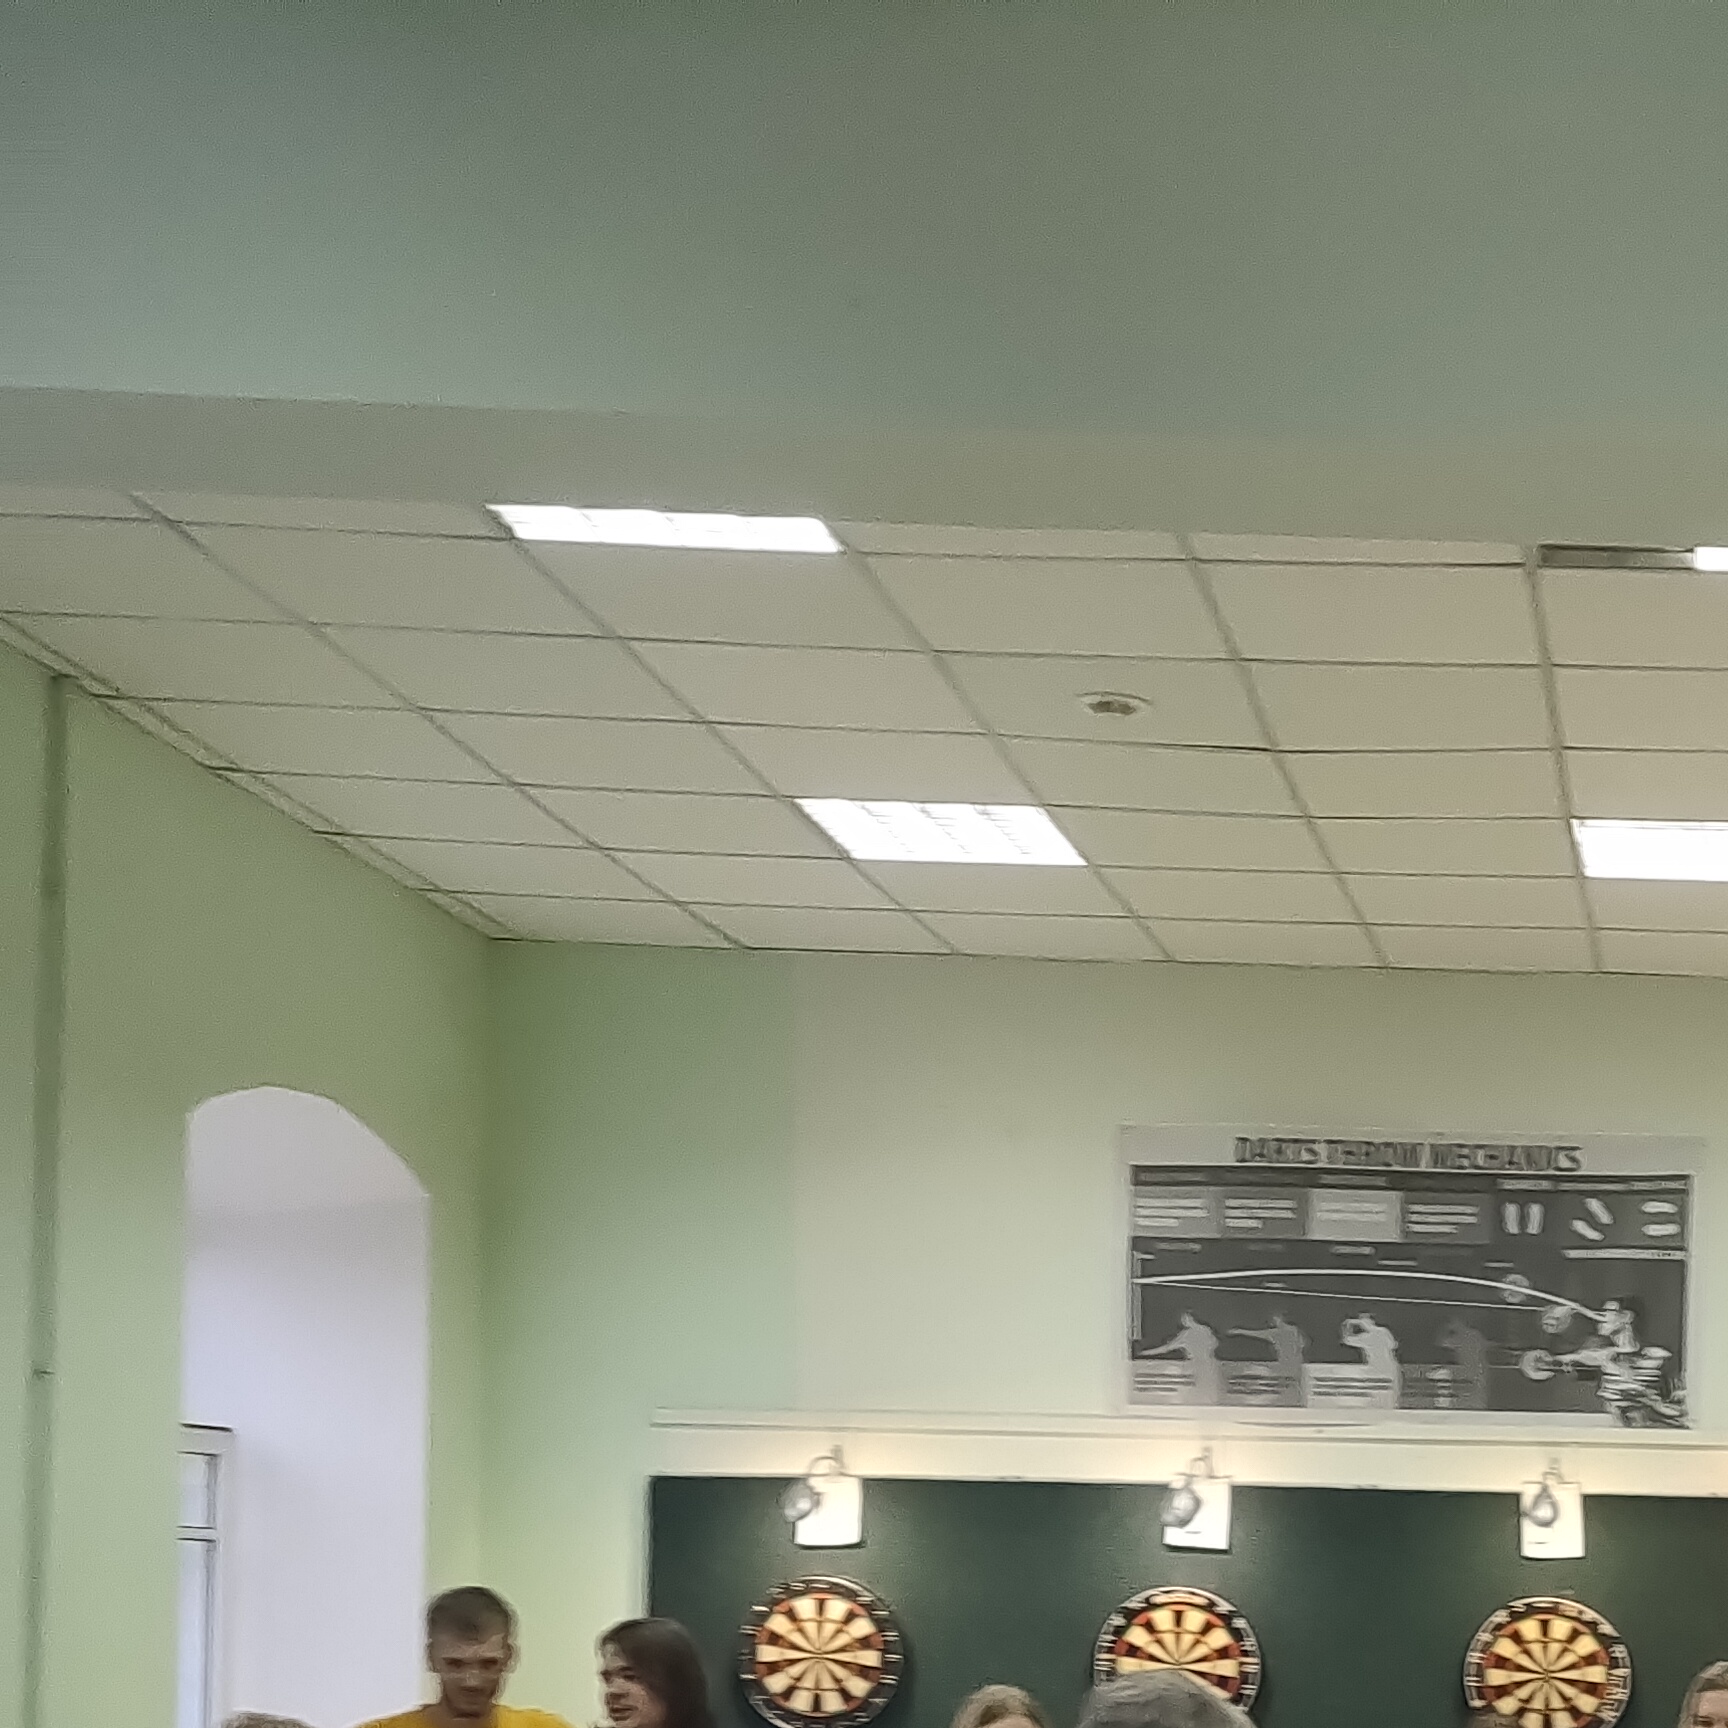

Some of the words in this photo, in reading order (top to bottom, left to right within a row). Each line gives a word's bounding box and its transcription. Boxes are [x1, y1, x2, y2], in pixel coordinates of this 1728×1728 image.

[1235, 1137, 1319, 1164] DARTS
[1322, 1138, 1423, 1168] THROW
[1428, 1143, 1583, 1172] MECHANICS
